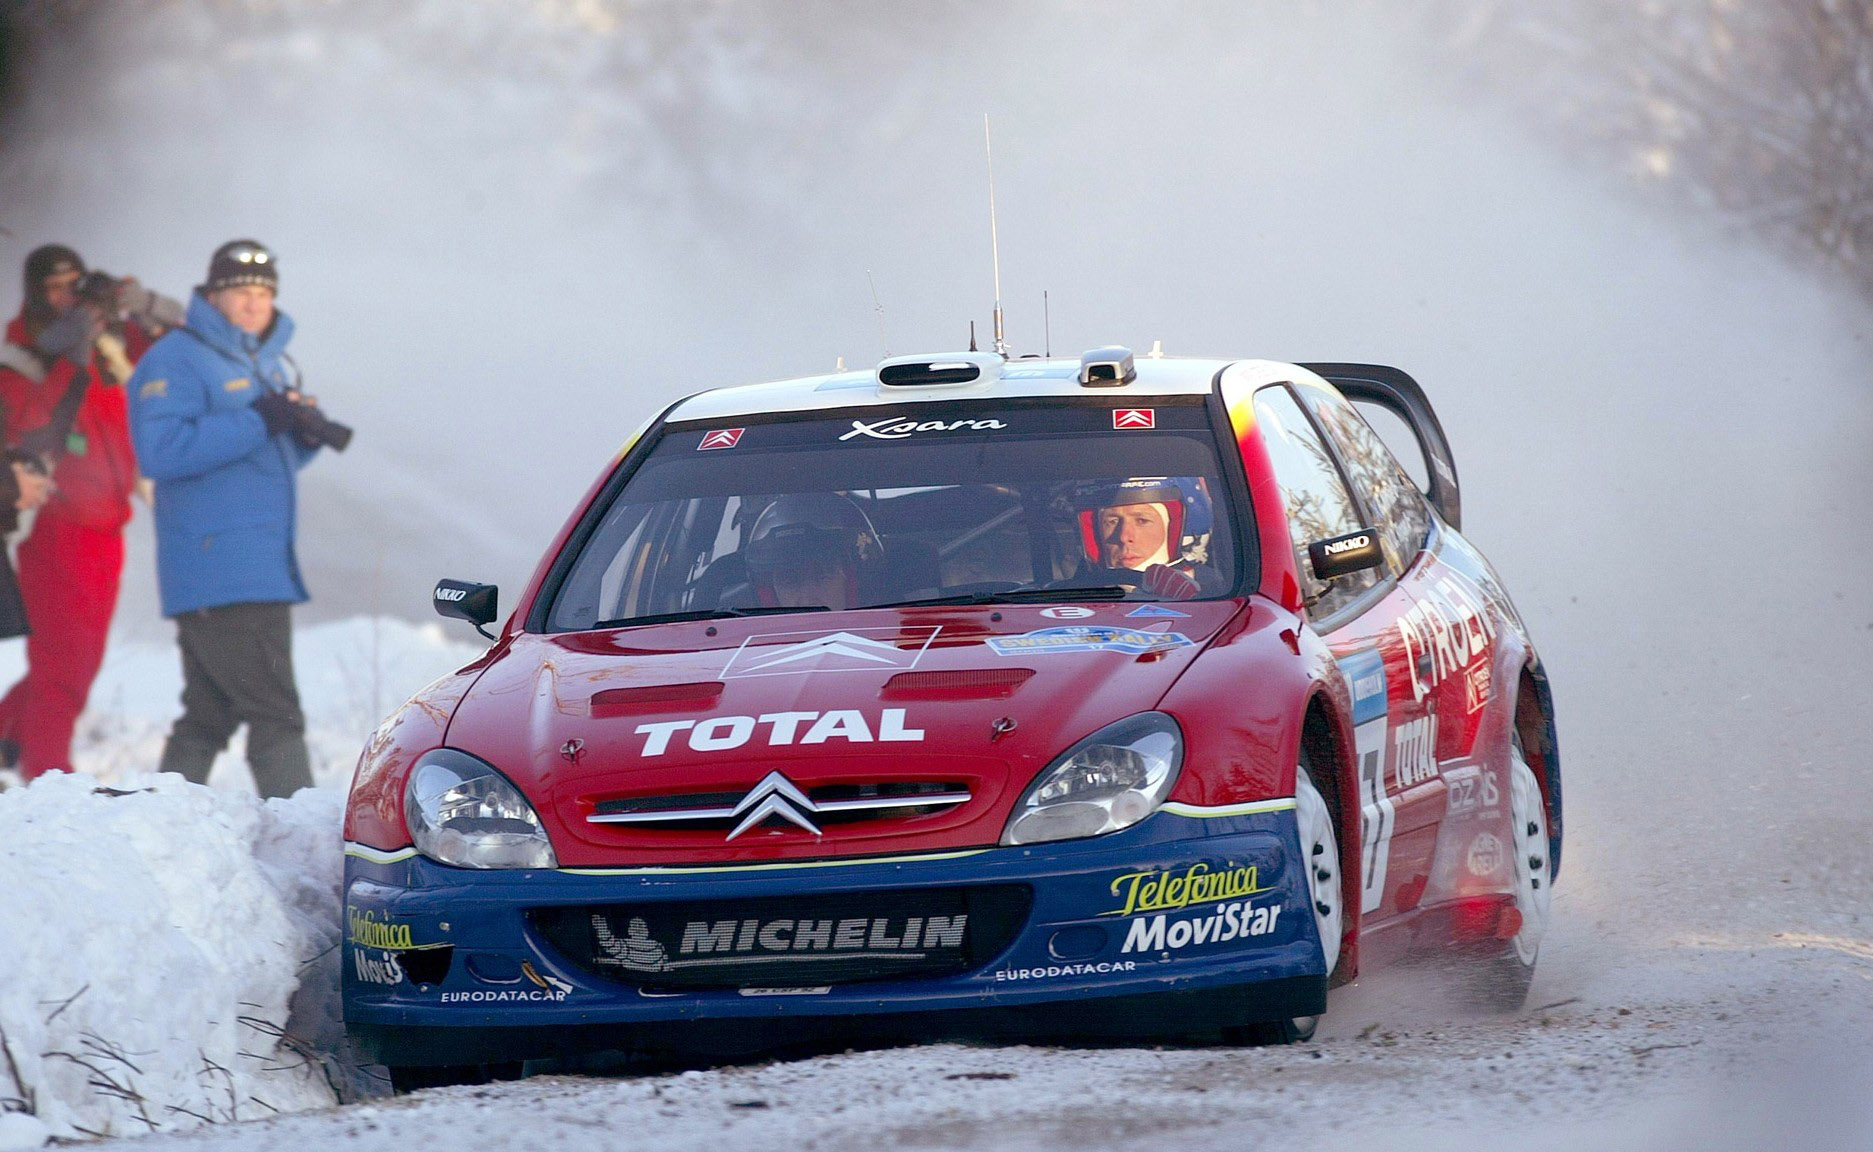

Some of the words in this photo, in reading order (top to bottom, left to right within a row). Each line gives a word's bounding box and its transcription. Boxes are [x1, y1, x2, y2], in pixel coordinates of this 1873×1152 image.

[838, 415, 1008, 442] Xsara
[1324, 535, 1370, 556] NIKKO
[433, 587, 467, 602] NIKKO
[634, 707, 925, 757] TOTAL
[1395, 714, 1439, 788] TOTAL
[679, 914, 968, 954] MICHELIN
[1120, 901, 1281, 954] MoviStar
[995, 960, 1136, 981] EURODATACAR
[441, 990, 566, 1003] EURODATACAR
